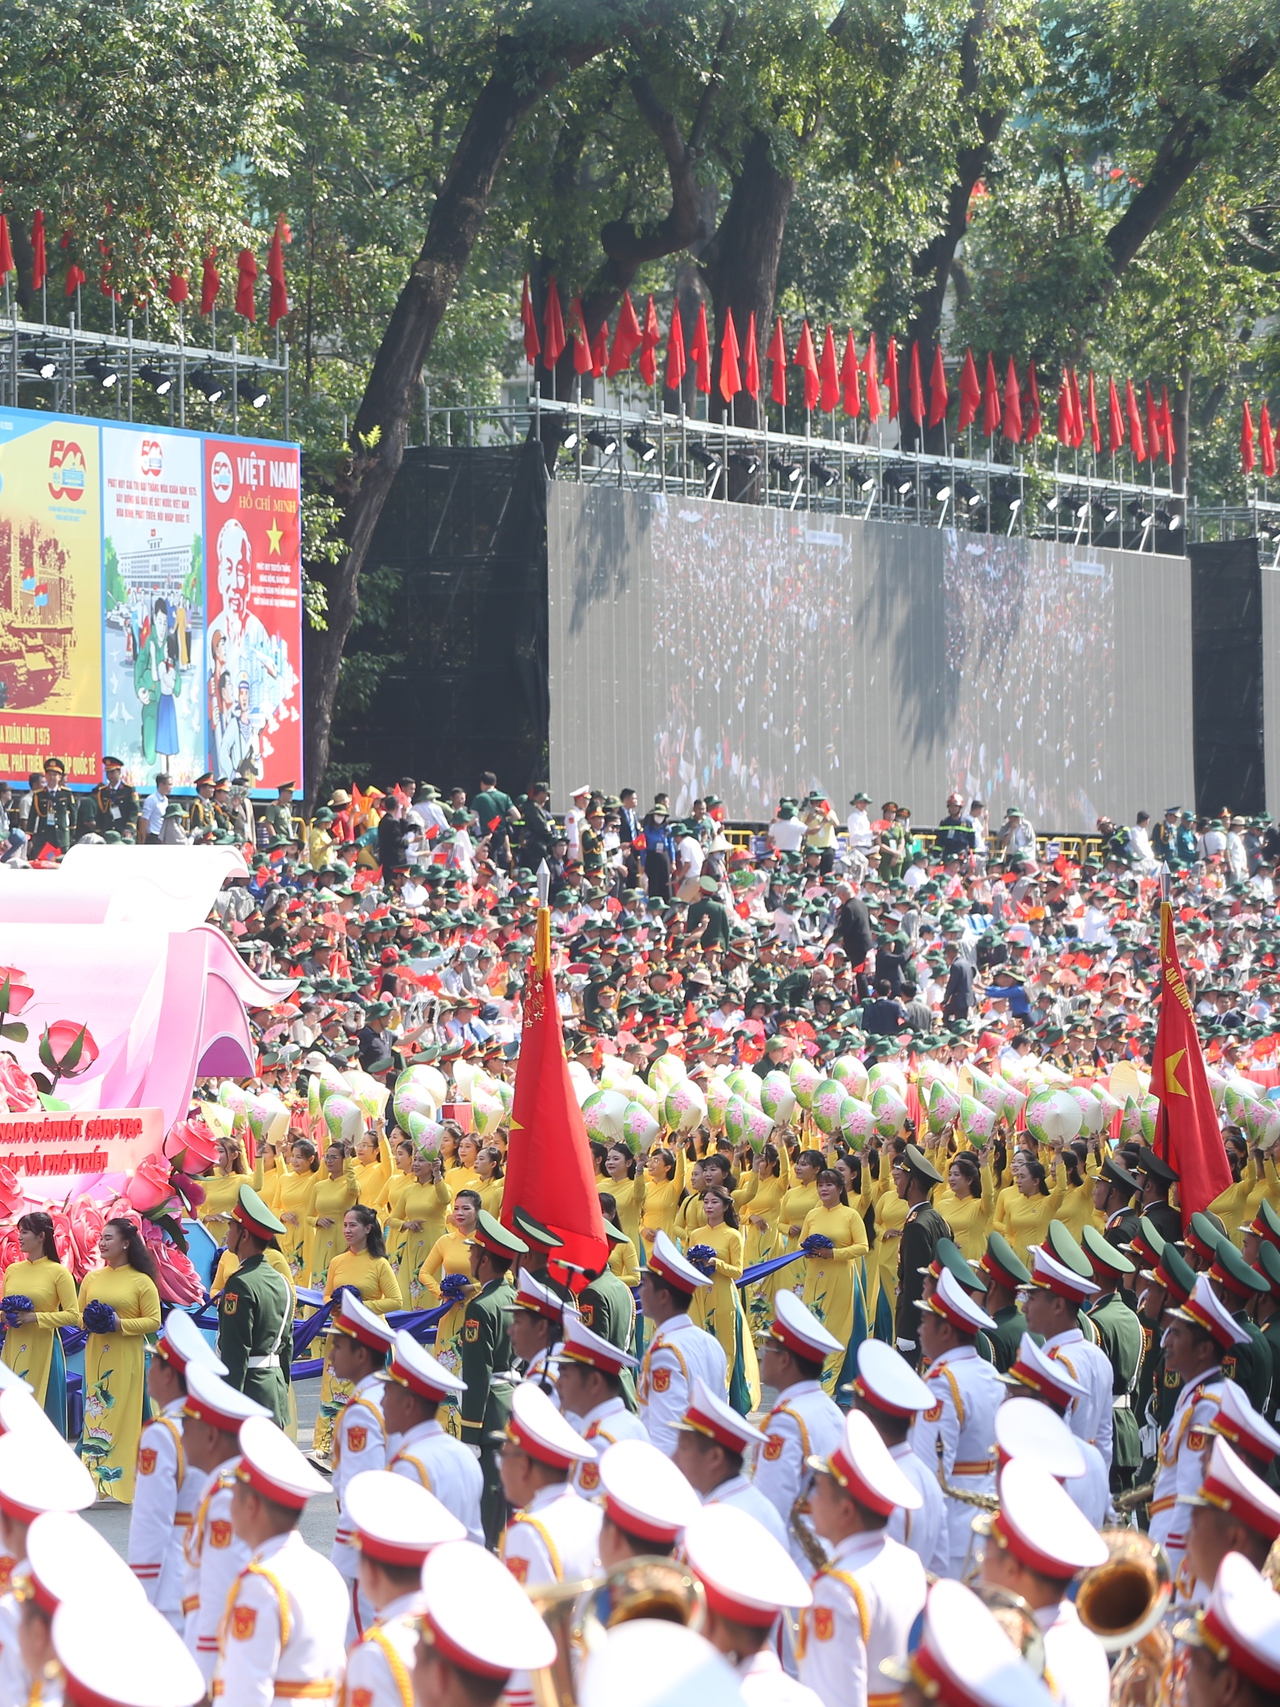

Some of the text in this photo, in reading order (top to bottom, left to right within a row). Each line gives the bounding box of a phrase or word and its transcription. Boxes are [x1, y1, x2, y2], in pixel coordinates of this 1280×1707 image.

[237, 451, 297, 491] VIỆT NAM
[239, 490, 296, 513] HỒ CHÍ MINH
